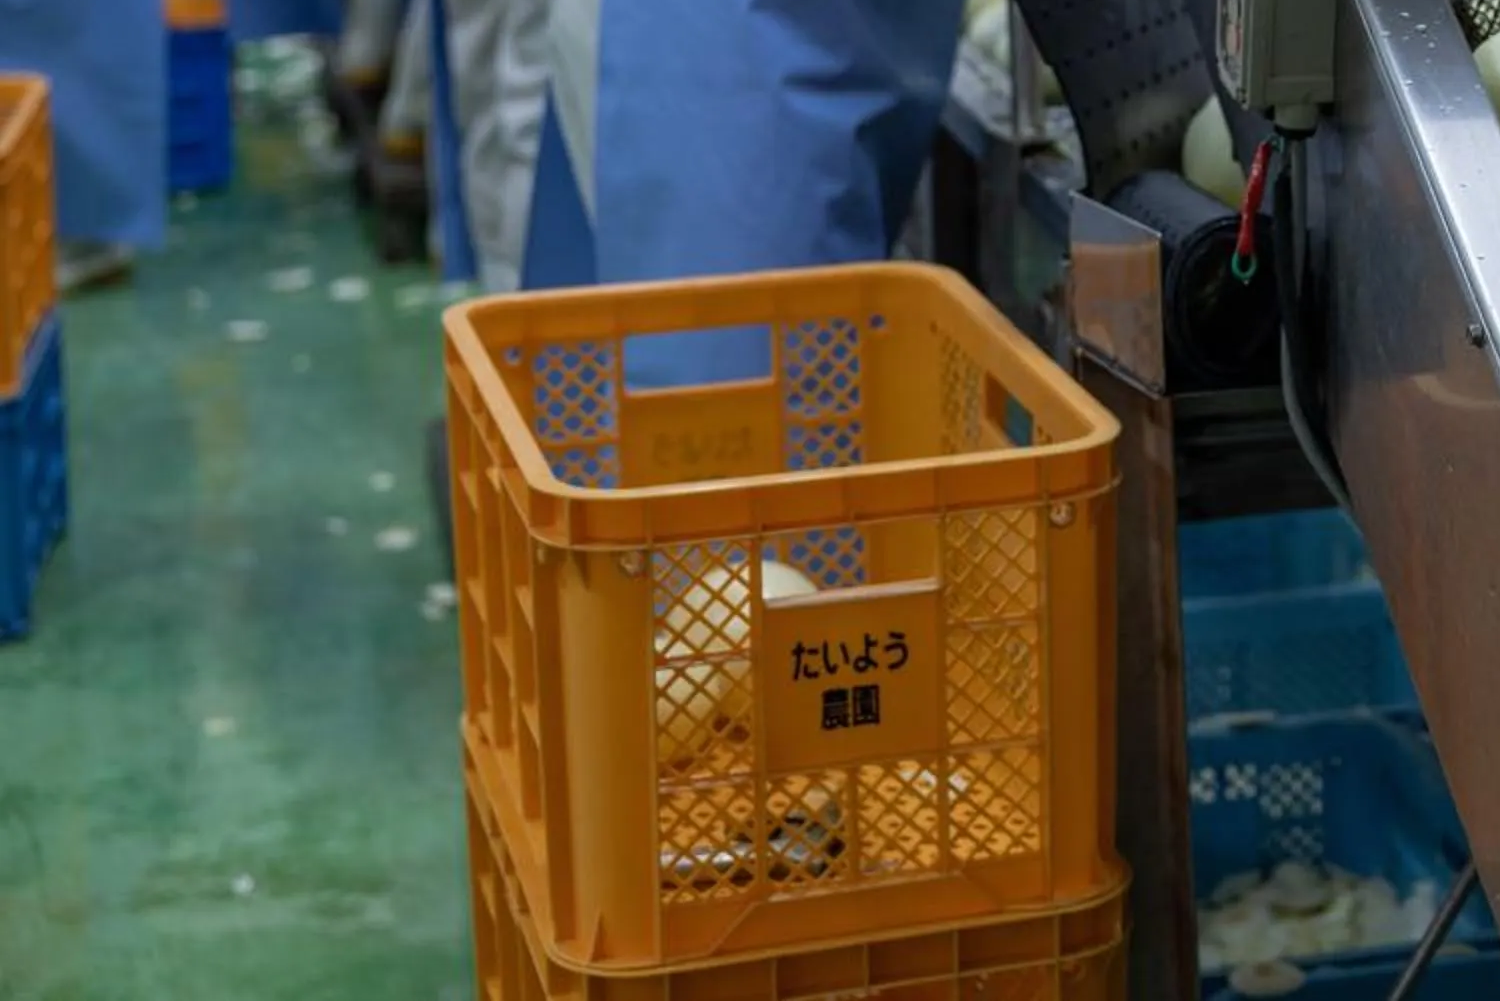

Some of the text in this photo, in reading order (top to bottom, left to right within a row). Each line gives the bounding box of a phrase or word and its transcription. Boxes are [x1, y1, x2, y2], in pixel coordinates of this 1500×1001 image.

[792, 632, 909, 681] たいよう
[821, 684, 880, 731] 農園
